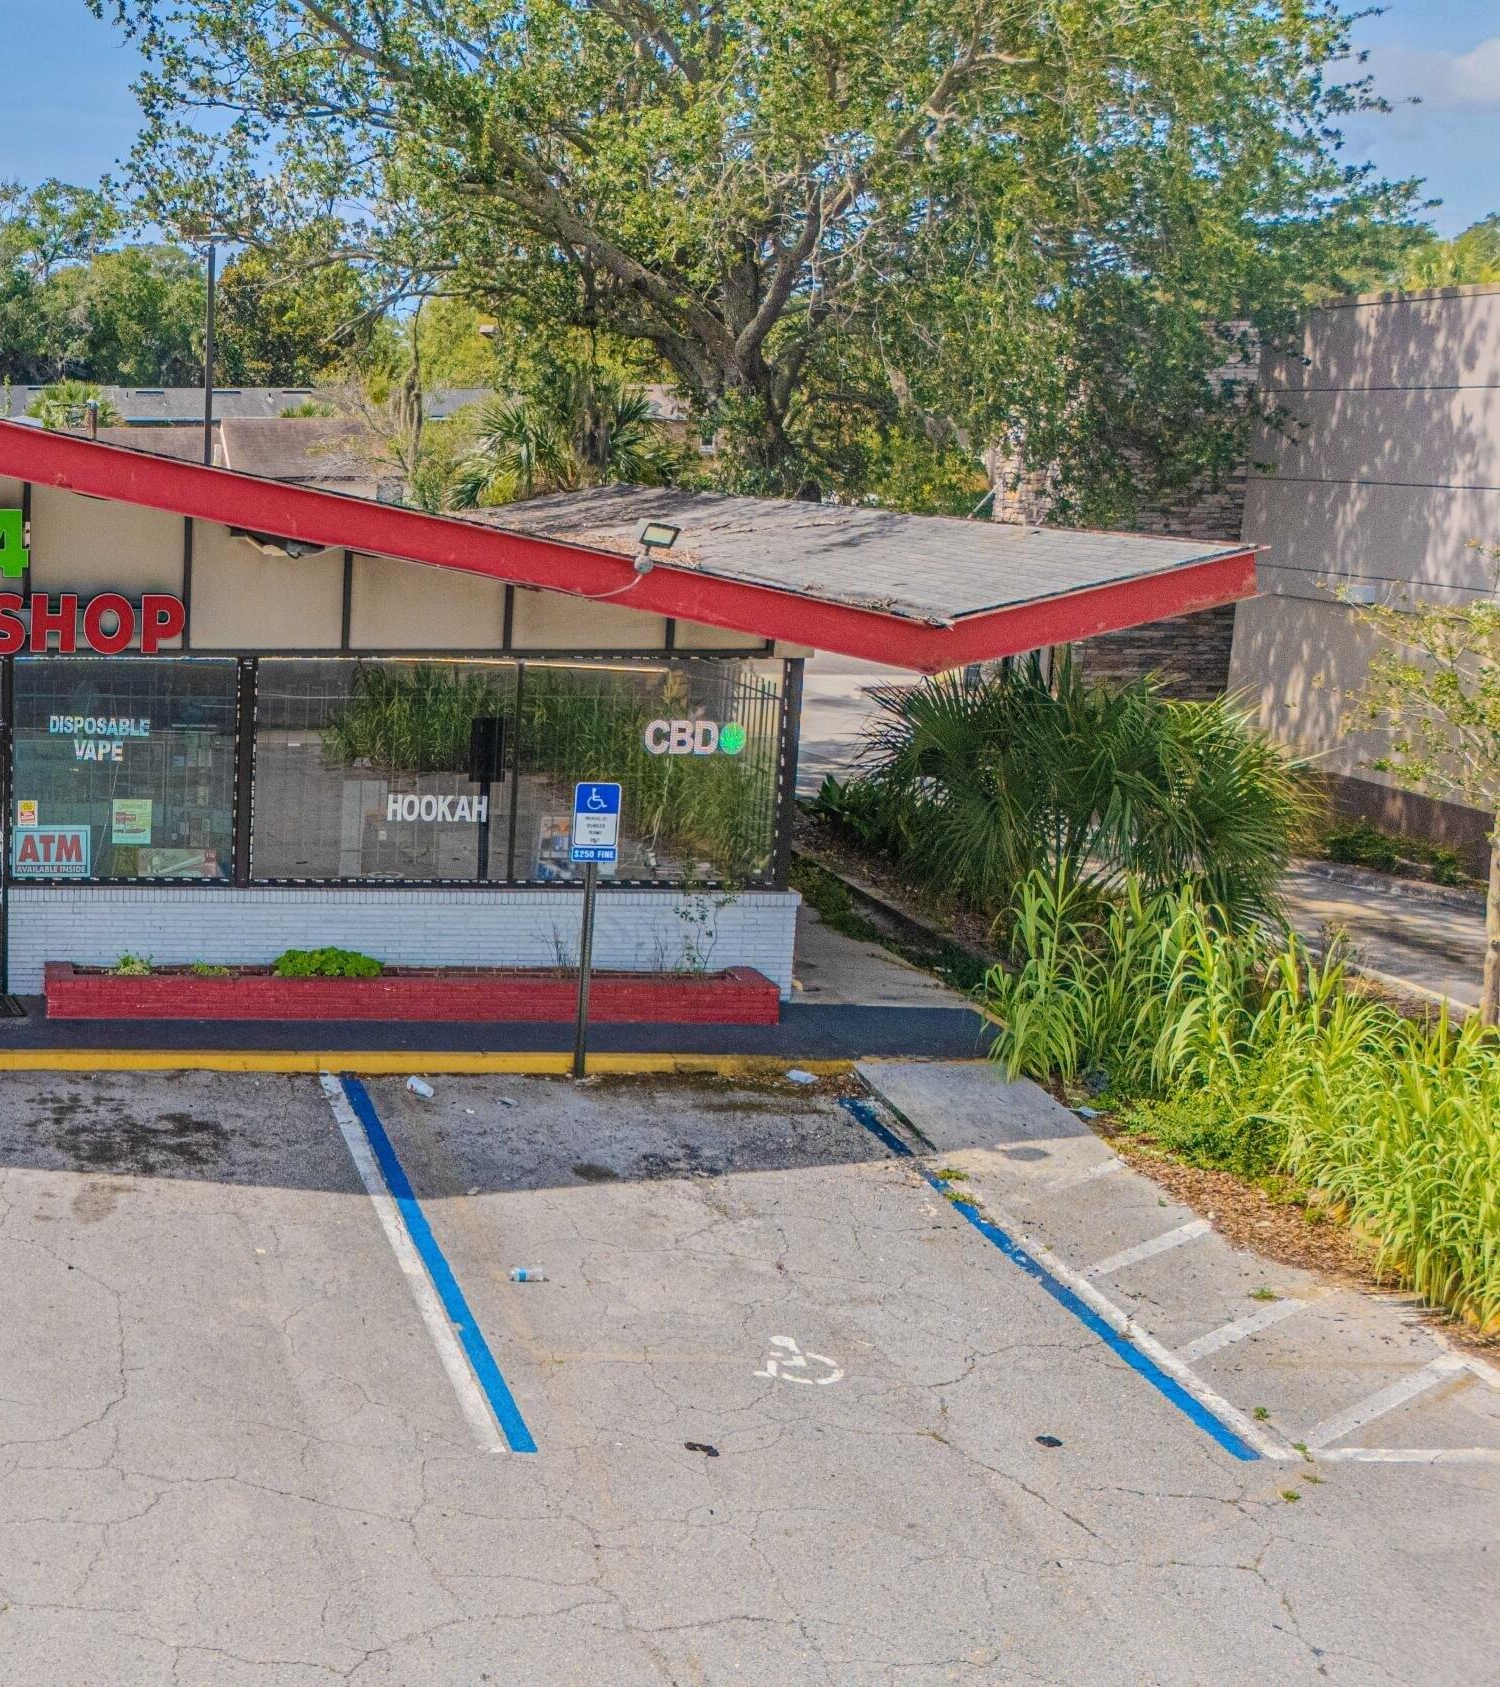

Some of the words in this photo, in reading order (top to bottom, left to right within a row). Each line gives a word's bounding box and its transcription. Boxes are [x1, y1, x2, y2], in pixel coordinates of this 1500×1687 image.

[49, 715, 150, 736] DISPOSABLE
[644, 720, 719, 755] CBD
[73, 739, 124, 761] VAPE
[387, 794, 488, 822] HOOKAH
[18, 834, 83, 863] ATM
[574, 850, 594, 858] $250
[597, 851, 614, 859] FINE
[16, 865, 58, 873] AVAILABLE
[59, 865, 86, 873] INSIDE
